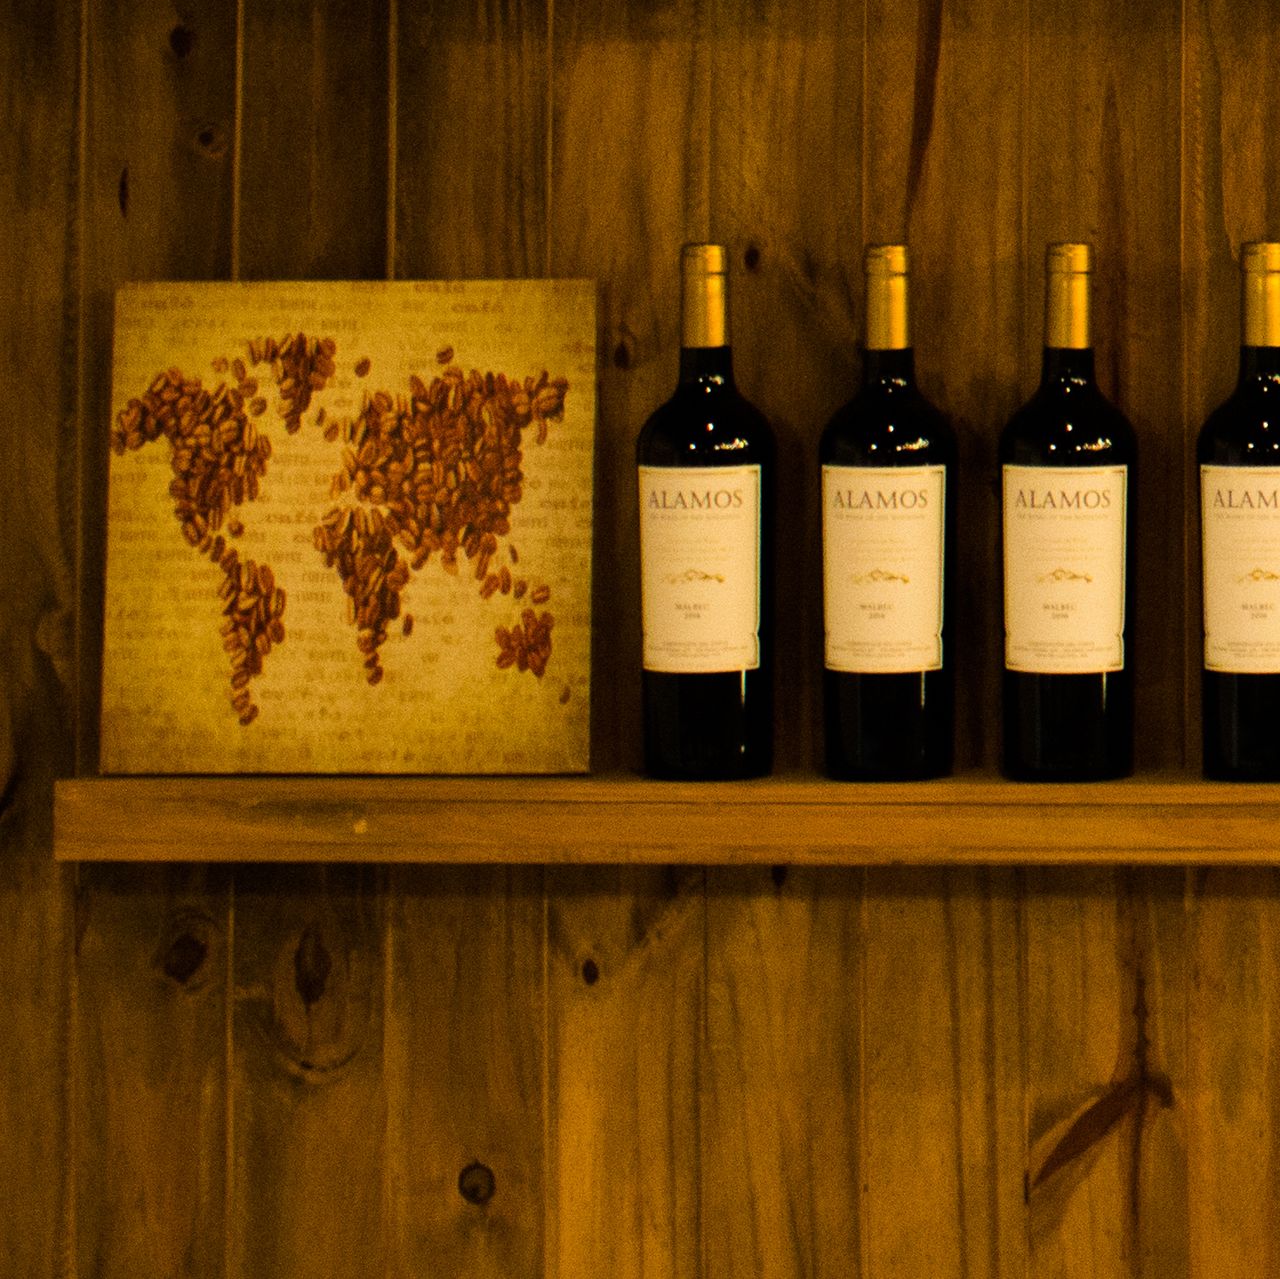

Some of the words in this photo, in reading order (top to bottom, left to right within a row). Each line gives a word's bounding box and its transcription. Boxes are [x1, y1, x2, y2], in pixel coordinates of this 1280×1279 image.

[649, 489, 743, 509] ALAMOS
[832, 489, 928, 509] ALAMOS
[1015, 489, 1111, 509] ALAMOS
